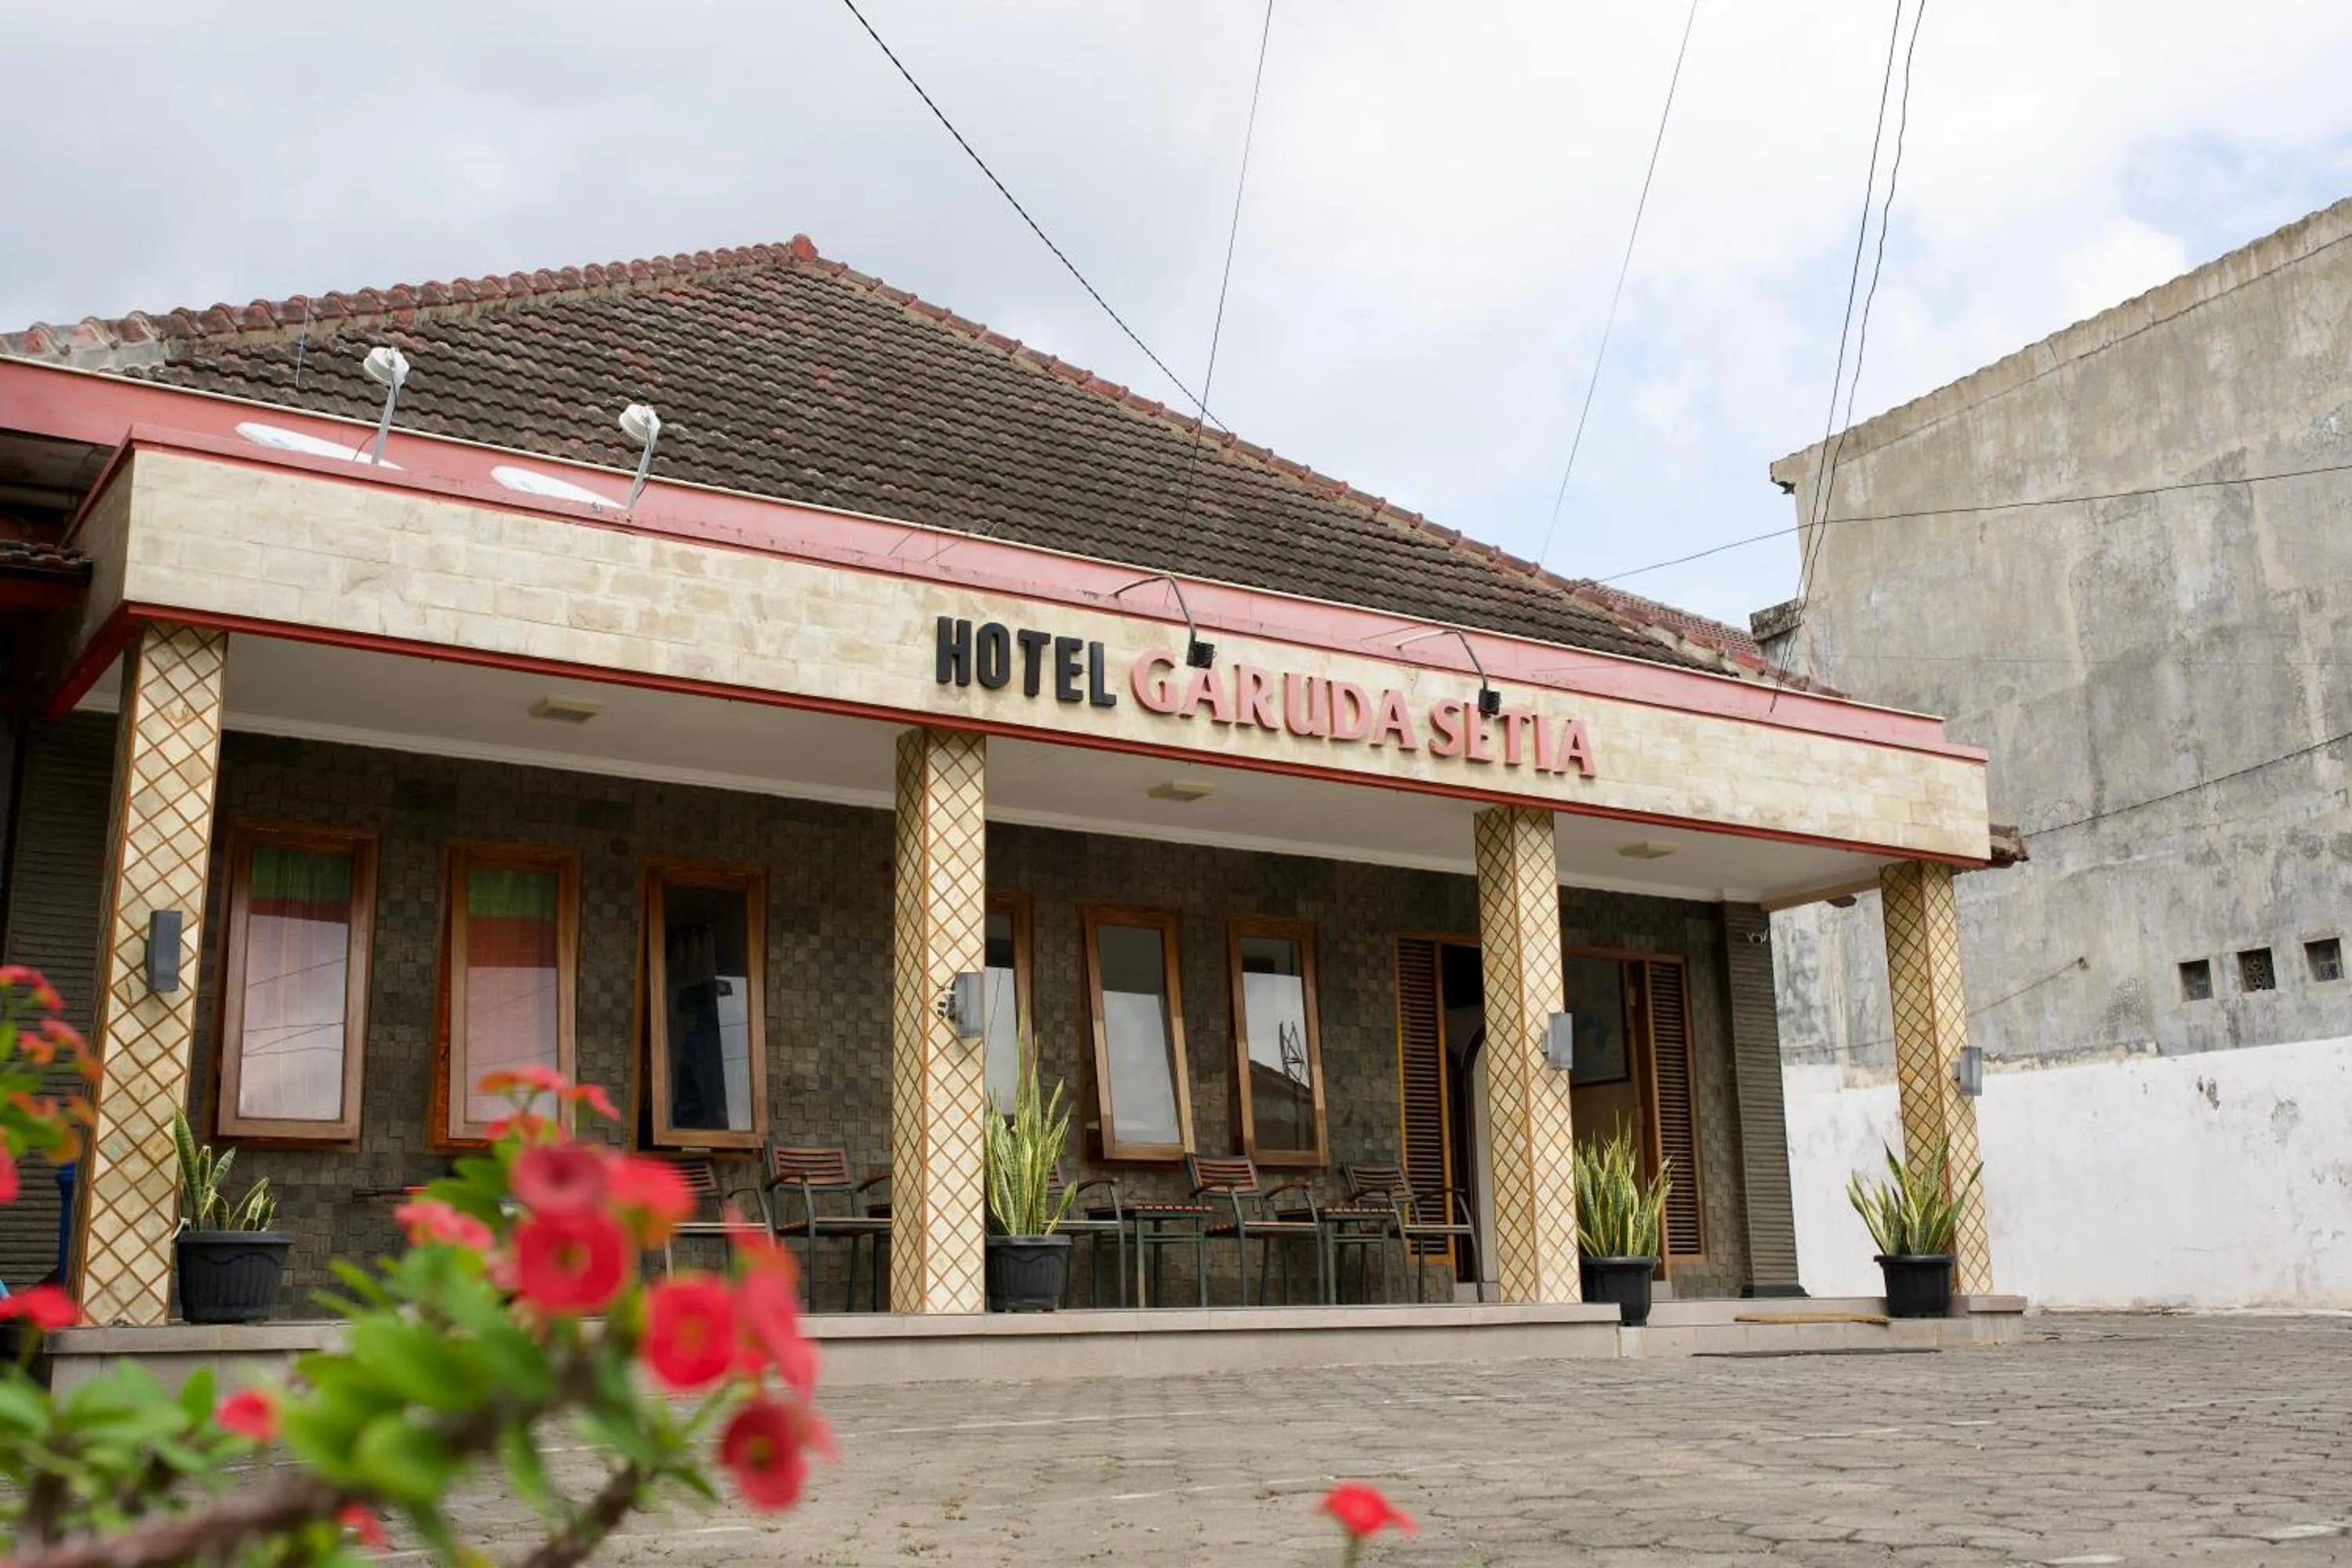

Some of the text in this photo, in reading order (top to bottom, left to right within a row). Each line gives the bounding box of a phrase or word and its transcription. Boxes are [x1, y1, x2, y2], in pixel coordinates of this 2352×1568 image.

[936, 616, 1596, 778] HOTEL GARUDA SETIA
